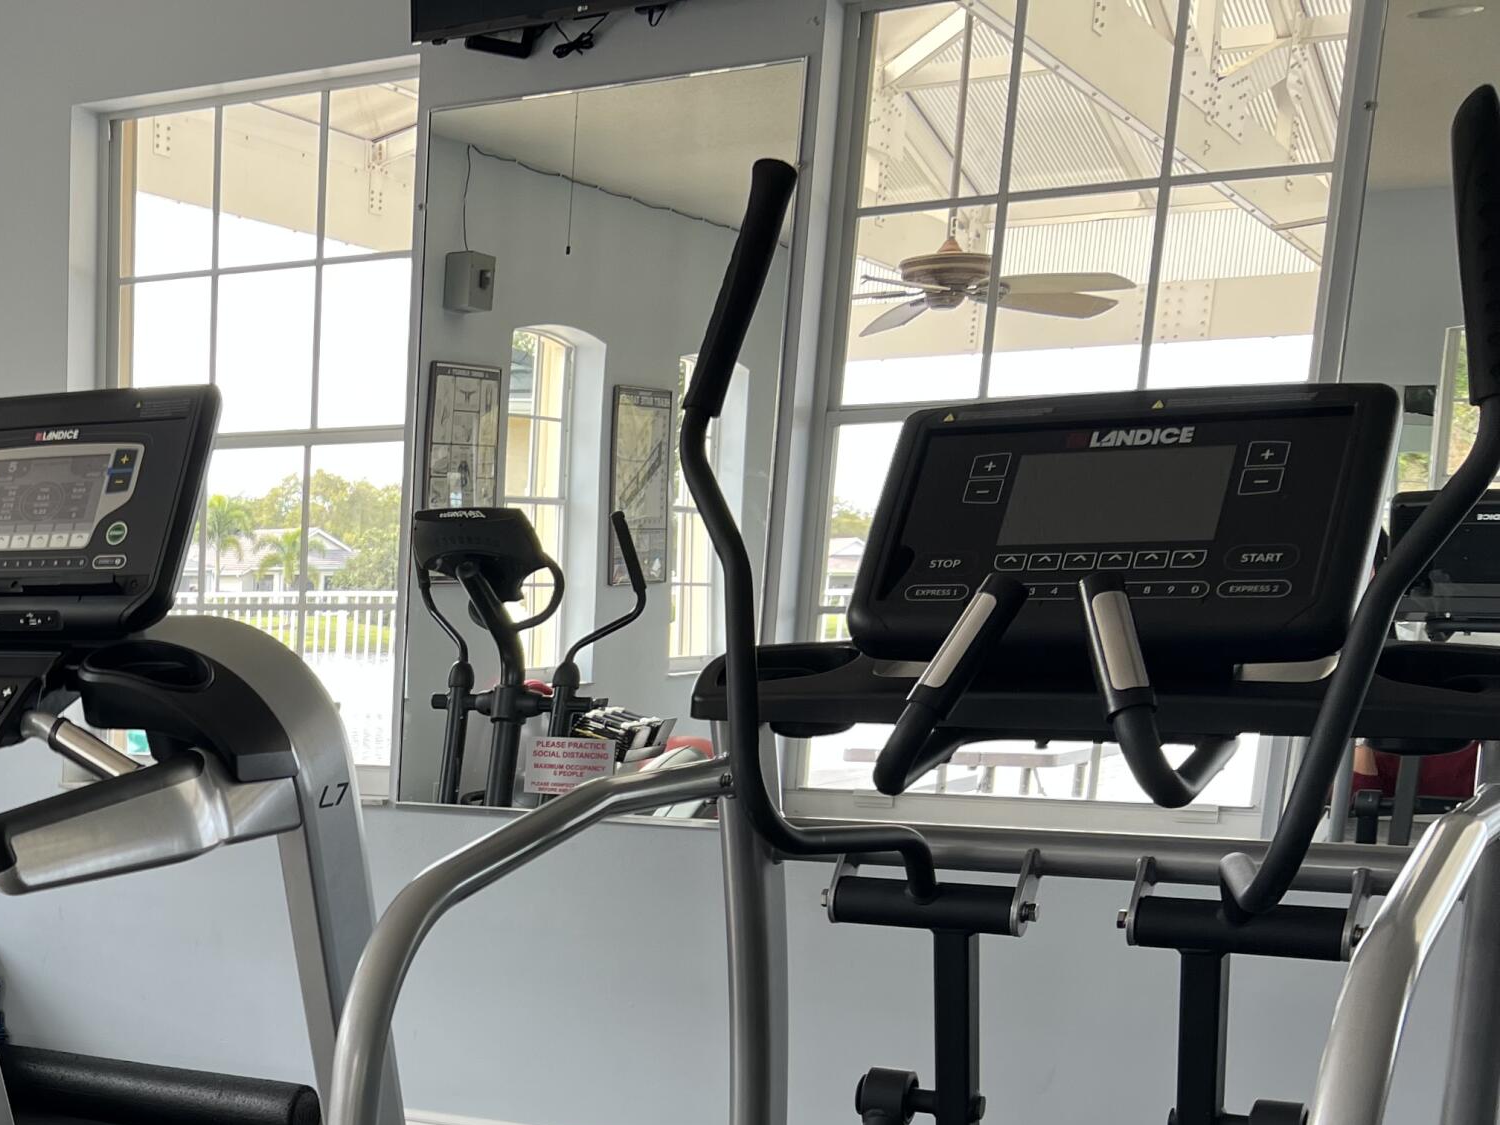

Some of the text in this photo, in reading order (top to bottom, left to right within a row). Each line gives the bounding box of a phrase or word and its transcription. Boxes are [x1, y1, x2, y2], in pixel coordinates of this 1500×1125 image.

[42, 429, 79, 441] LANDICE
[1088, 426, 1196, 448] LANDICE
[1240, 552, 1283, 563] START
[928, 559, 962, 568] STOP
[1028, 587, 1058, 596] 3 4
[1143, 586, 1151, 594] 8
[1167, 586, 1176, 594] 9
[1228, 585, 1271, 593] EXPRESS
[536, 740, 566, 748] PLEASE
[563, 752, 609, 760] DISTANCING
[318, 782, 349, 808] L7
